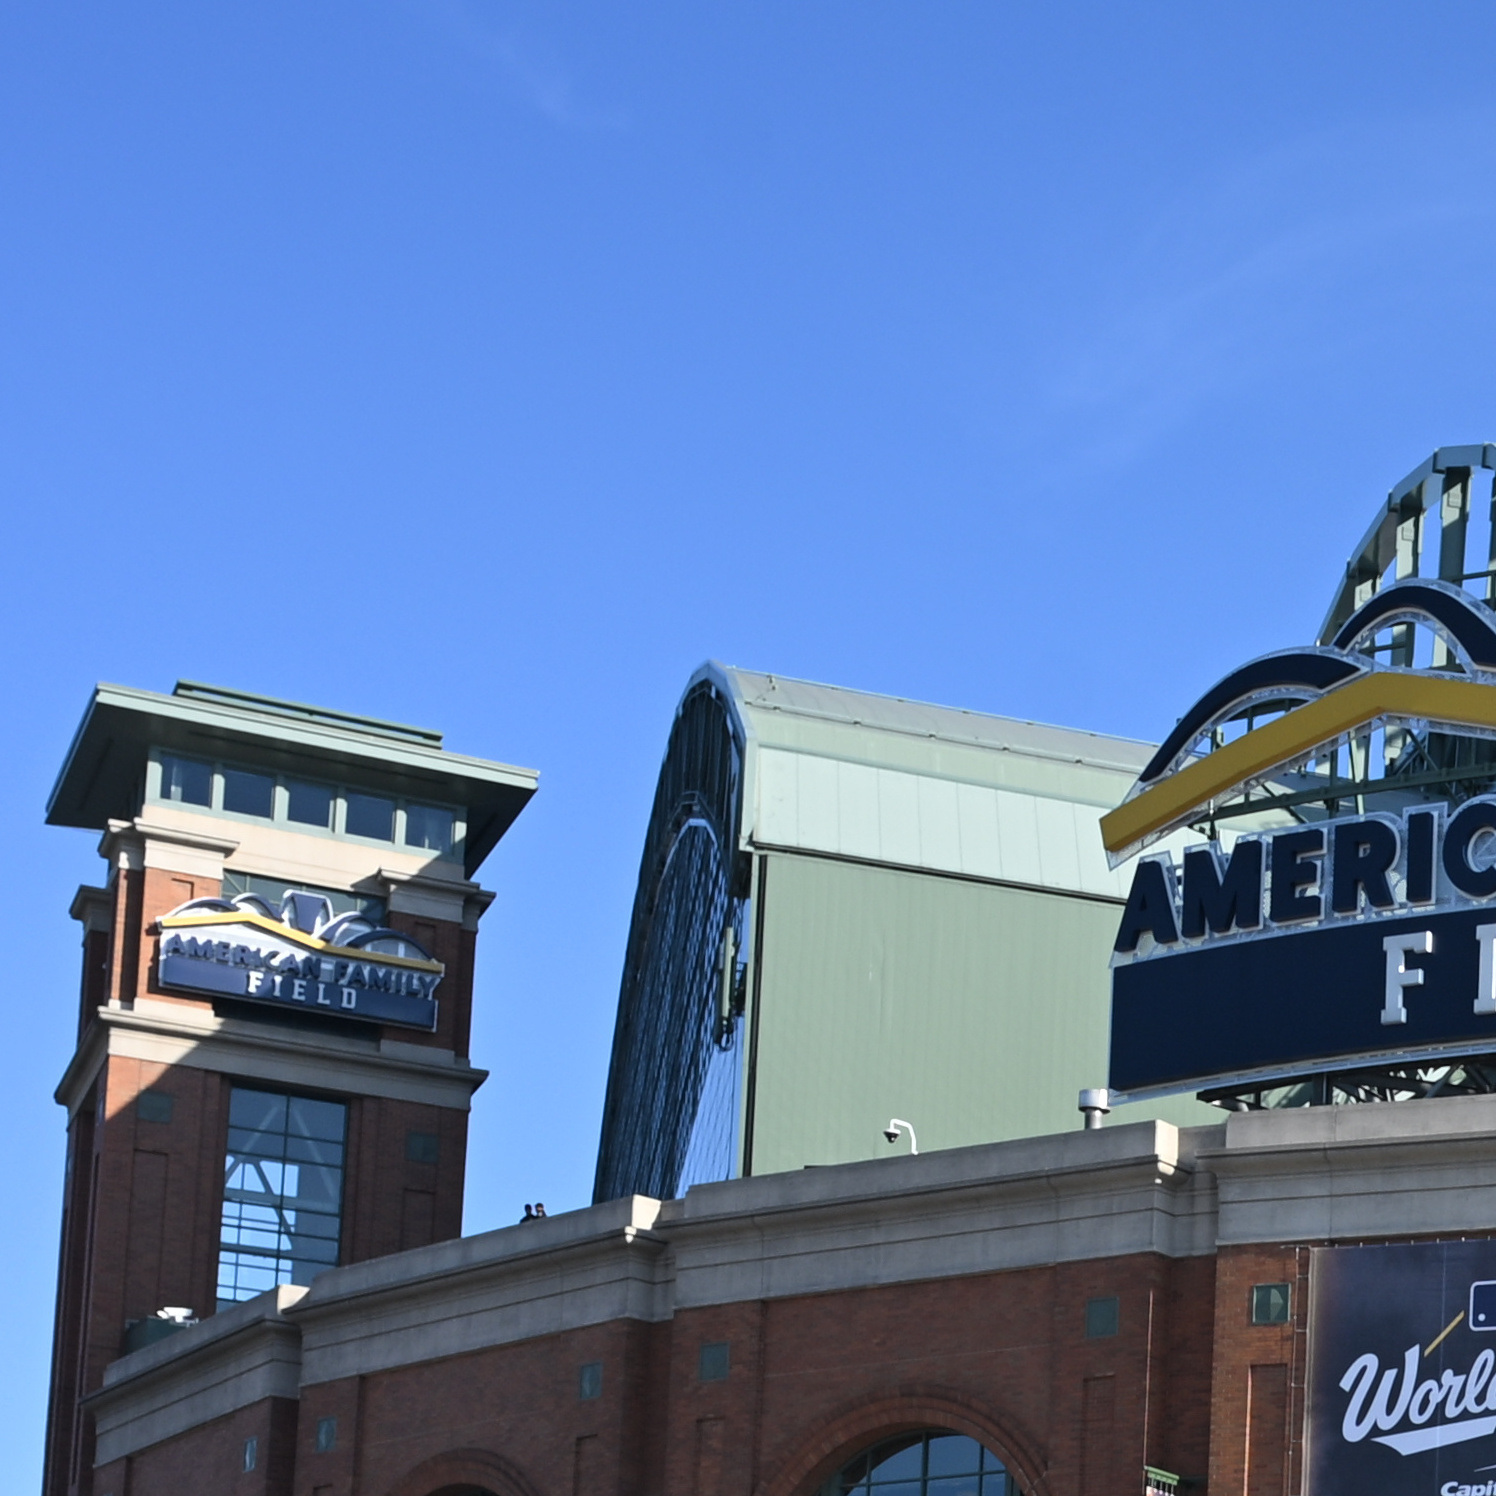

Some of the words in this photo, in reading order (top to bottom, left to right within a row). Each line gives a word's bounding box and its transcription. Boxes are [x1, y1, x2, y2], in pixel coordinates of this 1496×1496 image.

[165, 933, 322, 980] AMERICAN
[334, 960, 441, 1000] FAMILY
[248, 971, 357, 1010] FIELD
